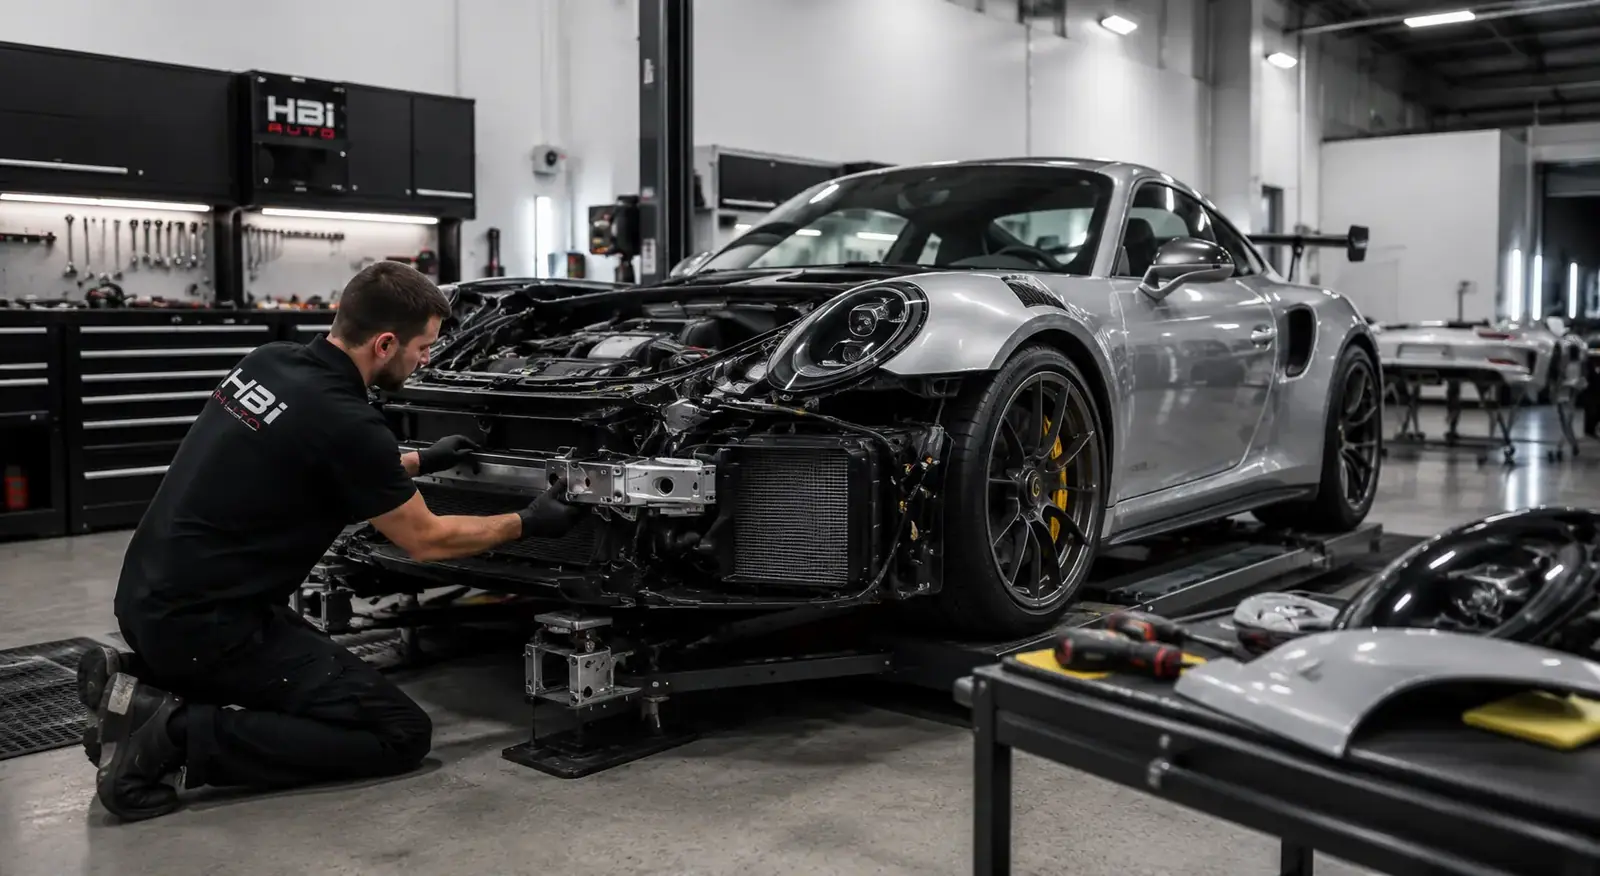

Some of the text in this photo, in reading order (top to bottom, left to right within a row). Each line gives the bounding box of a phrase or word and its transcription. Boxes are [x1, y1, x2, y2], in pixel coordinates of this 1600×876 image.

[267, 95, 335, 128] HBi
[267, 122, 336, 140] AUTO
[221, 367, 288, 425] HBi
